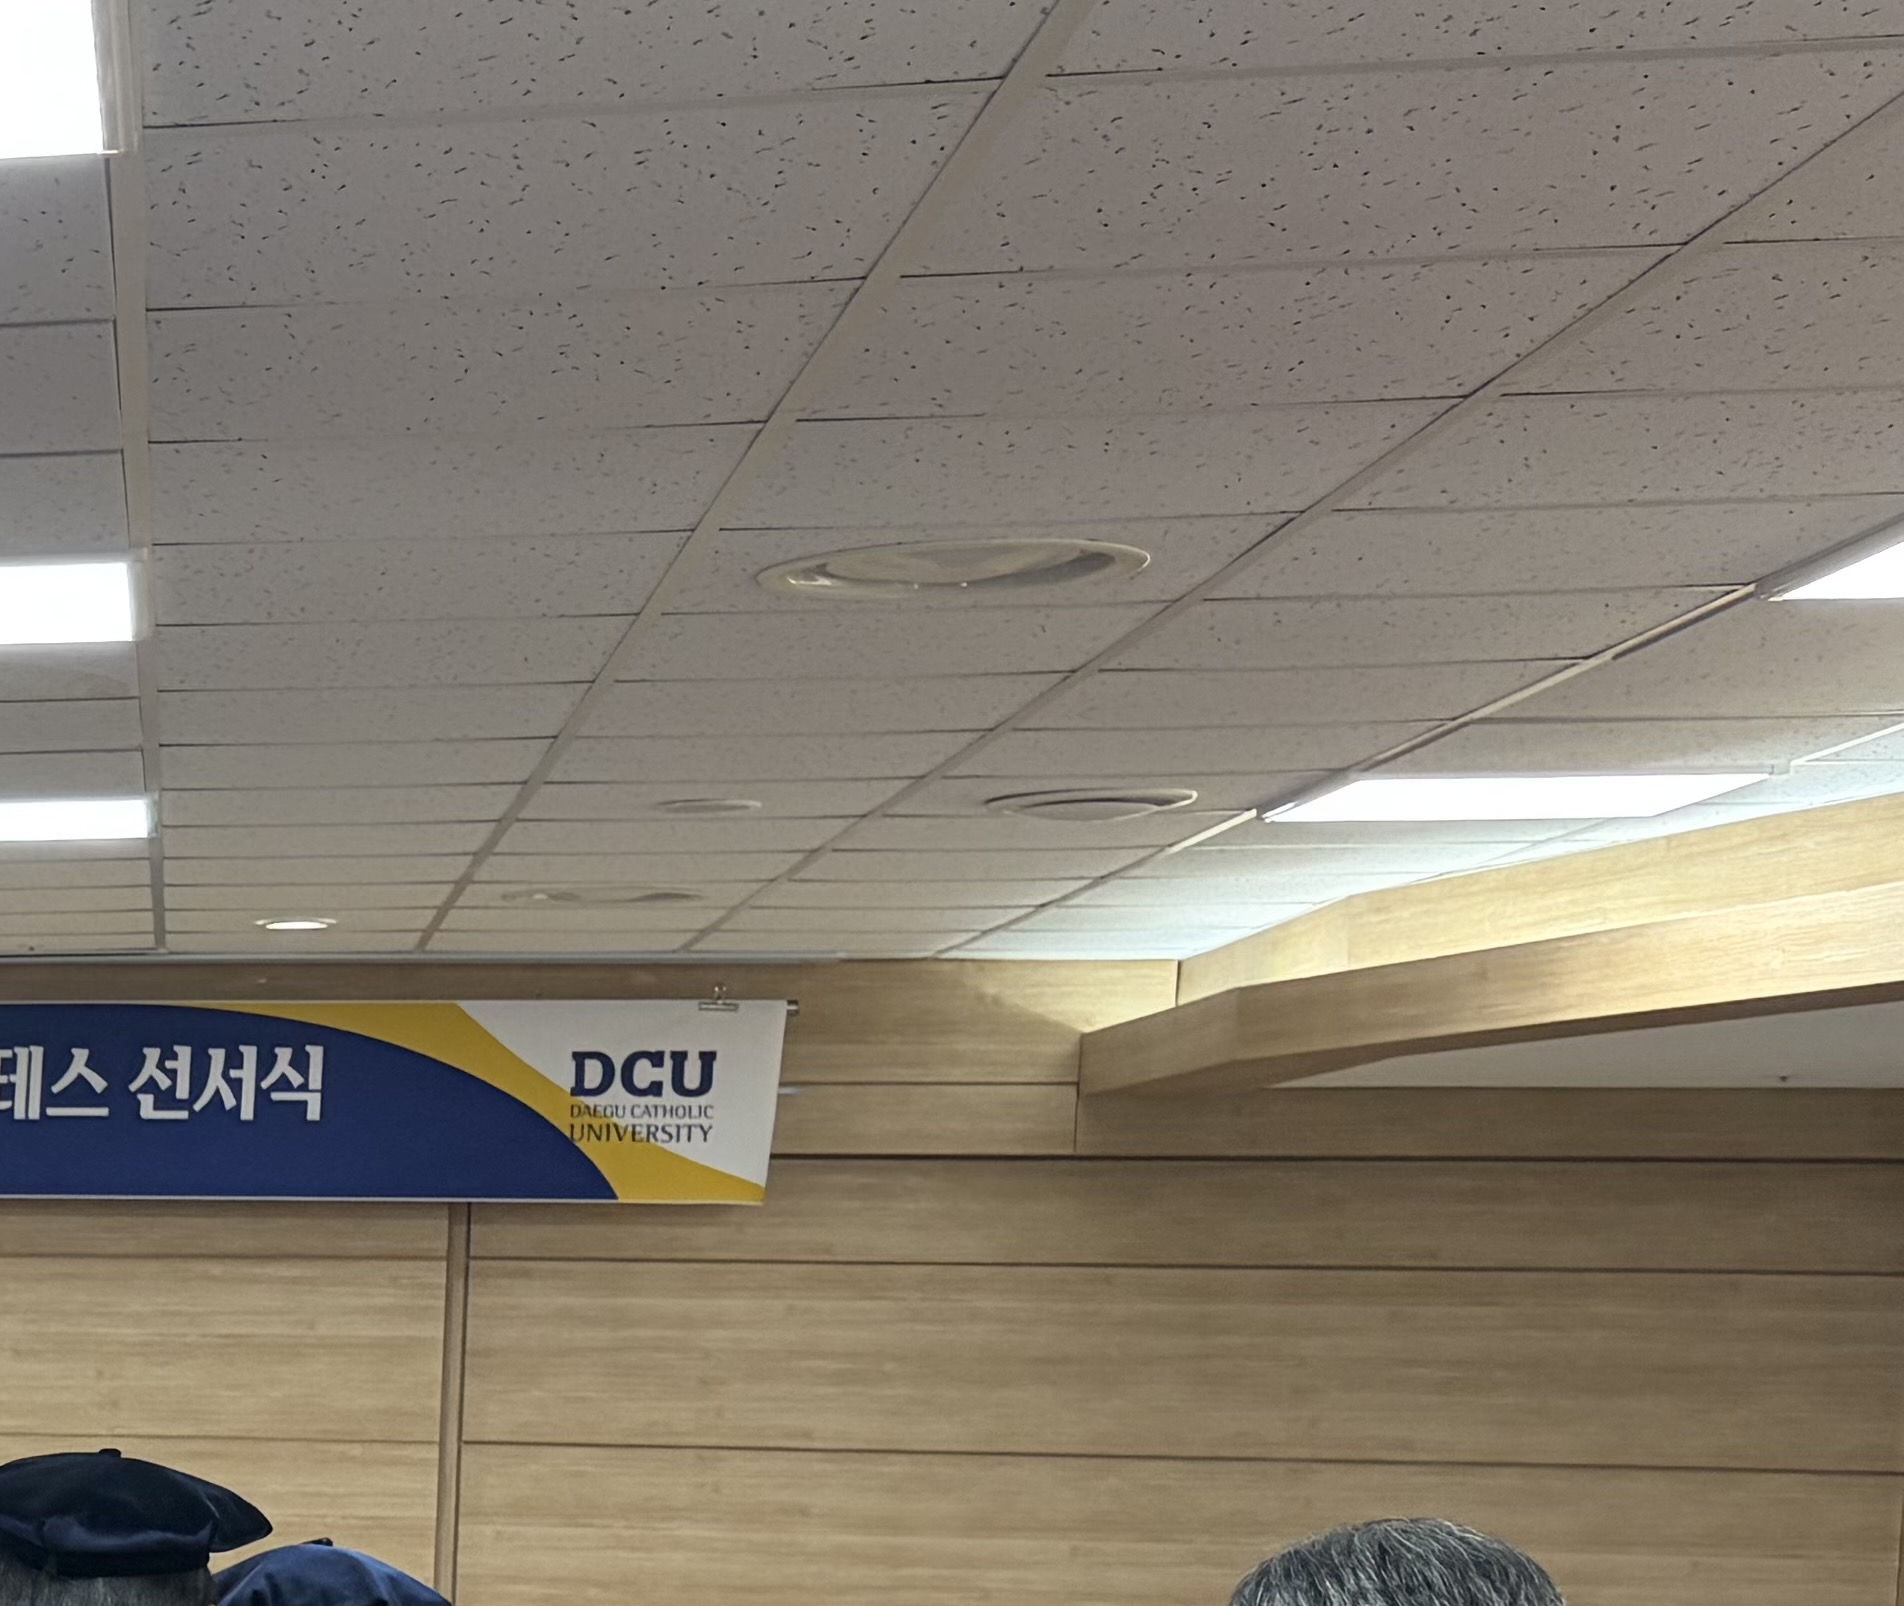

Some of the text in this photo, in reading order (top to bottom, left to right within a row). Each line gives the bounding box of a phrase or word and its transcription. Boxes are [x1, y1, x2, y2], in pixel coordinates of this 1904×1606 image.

[128, 1045, 324, 1121] 선서식
[570, 1050, 717, 1097] DCU
[570, 1104, 715, 1119] DAEGU CATHOLIC
[569, 1123, 713, 1143] UNIVERSITY
